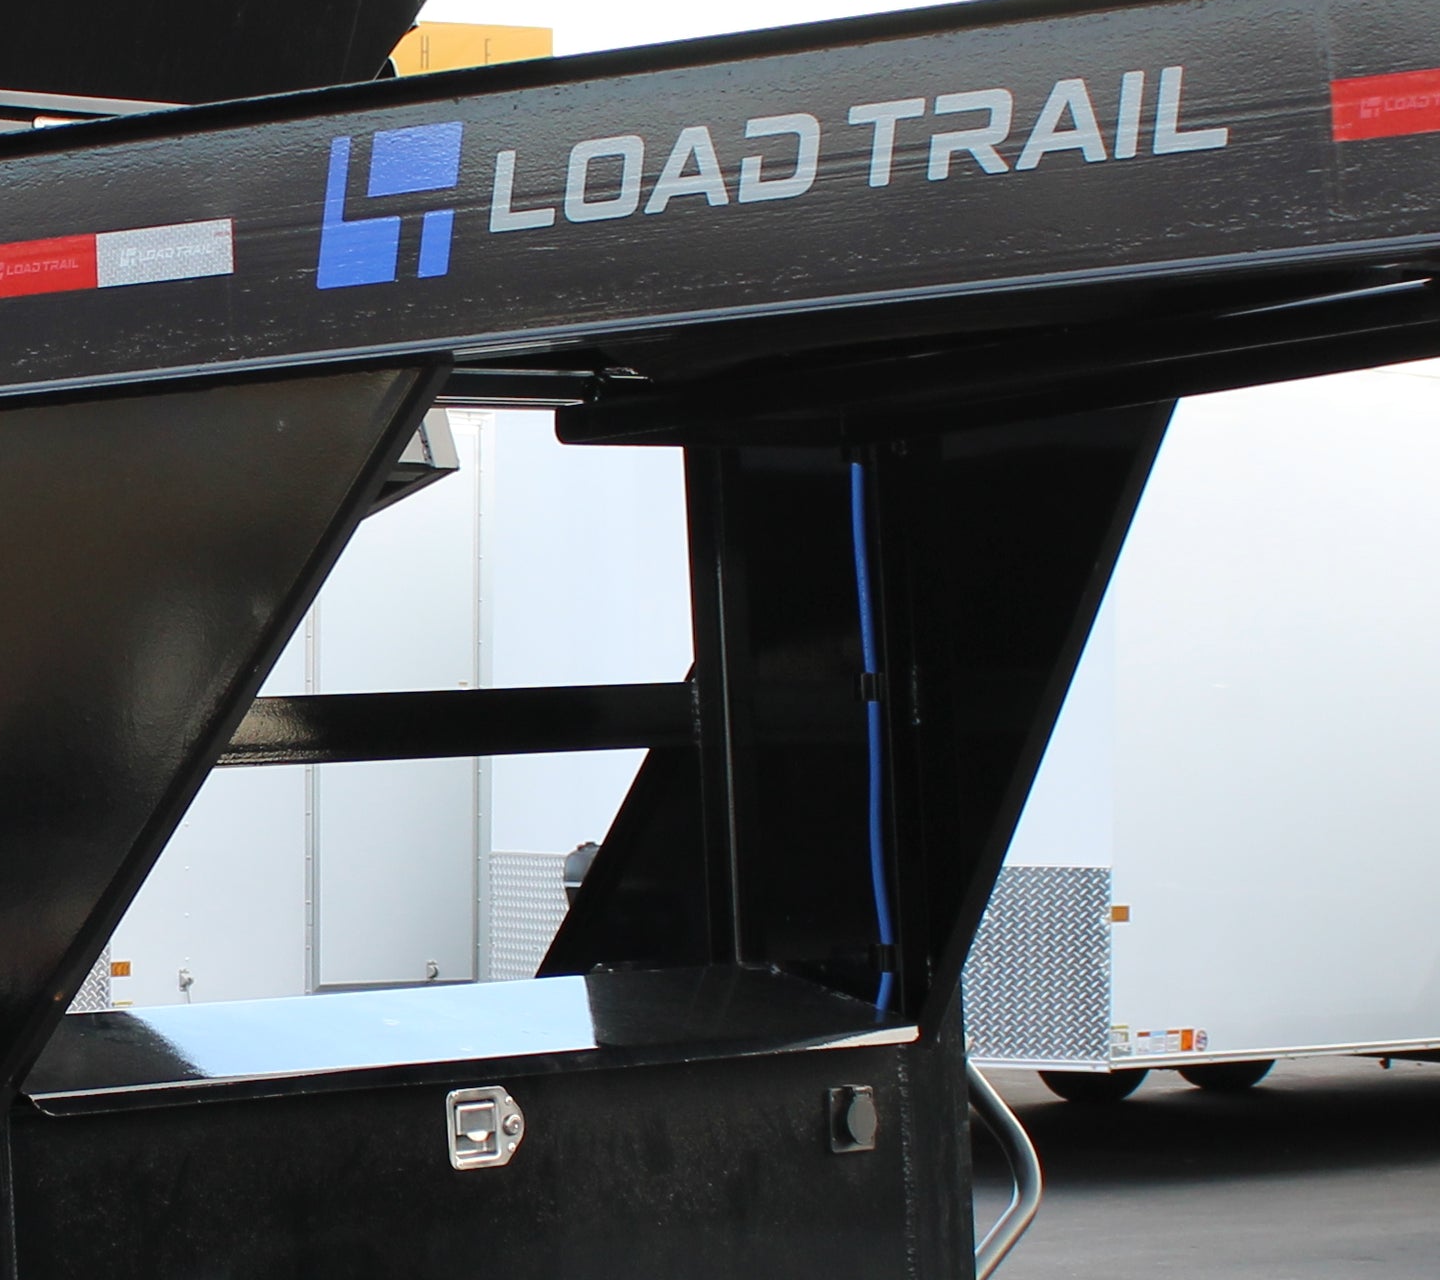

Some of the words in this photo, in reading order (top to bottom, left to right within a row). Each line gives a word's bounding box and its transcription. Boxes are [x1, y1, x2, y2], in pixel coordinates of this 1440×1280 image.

[489, 112, 821, 233] LOAD
[847, 65, 1230, 188] TRAIL
[6, 261, 41, 276] LOAD
[42, 258, 79, 272] TRAIL
